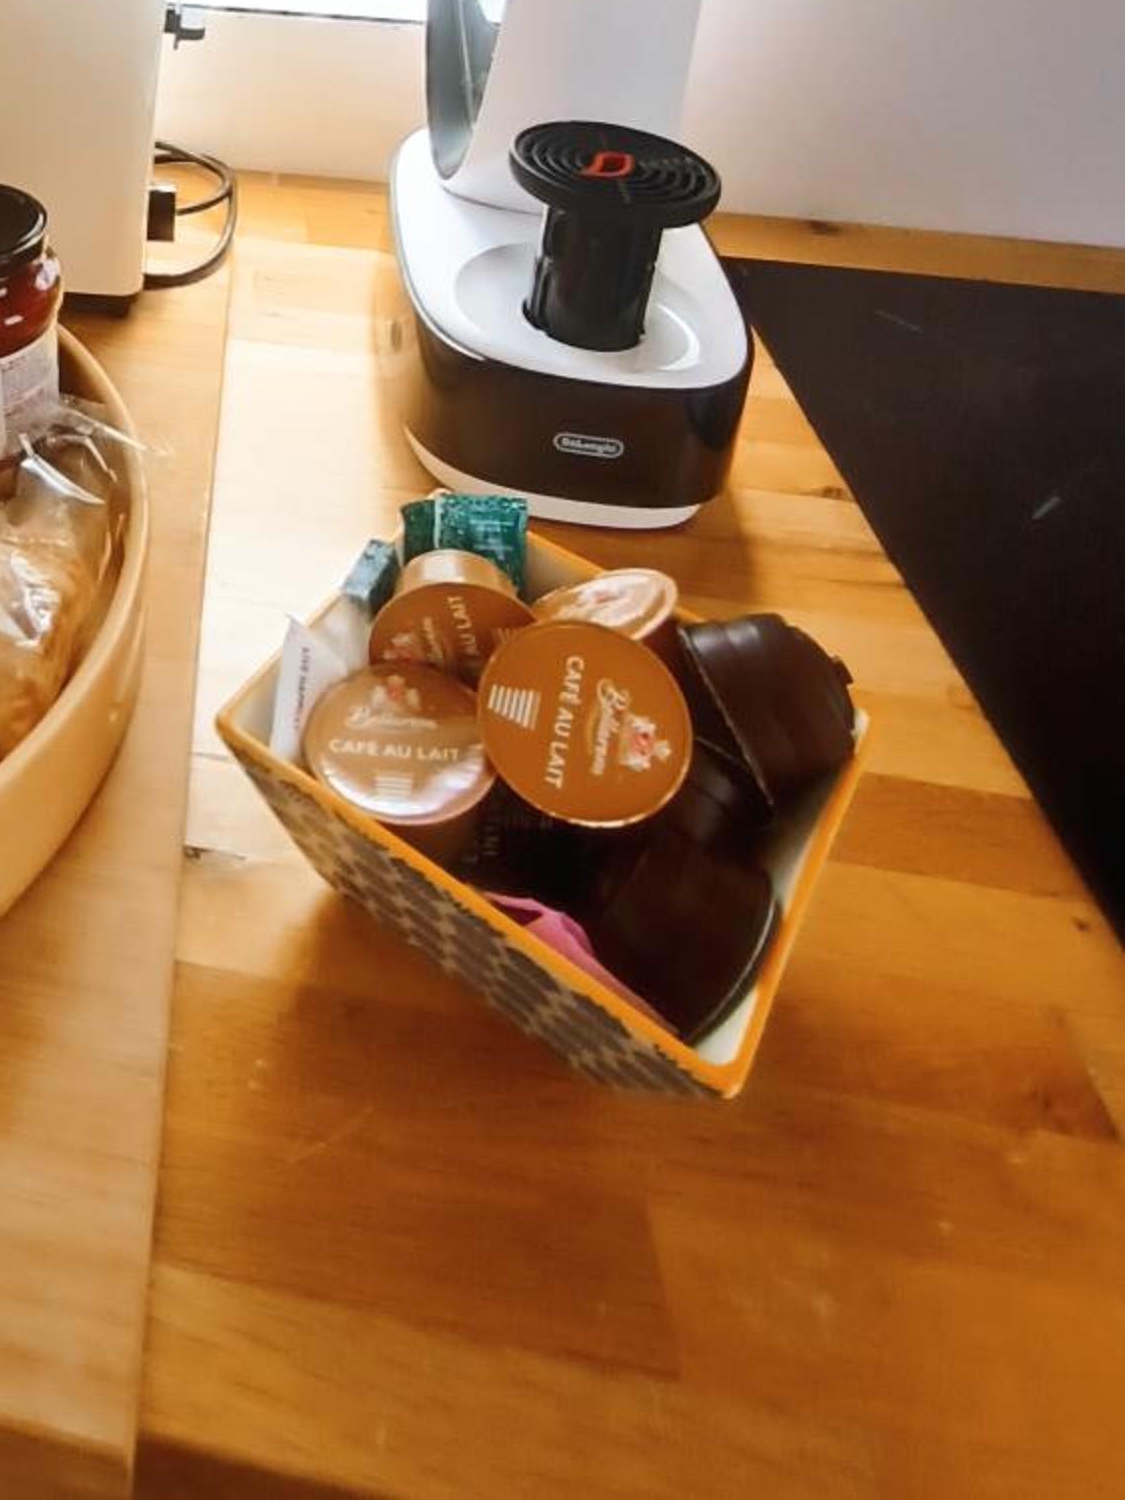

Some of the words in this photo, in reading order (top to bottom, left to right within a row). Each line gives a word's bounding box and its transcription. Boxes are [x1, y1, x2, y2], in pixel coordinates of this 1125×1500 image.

[554, 705, 574, 739] AU
[381, 743, 412, 758] AU
[416, 746, 459, 761] LAIT
[543, 740, 568, 789] LAIT
